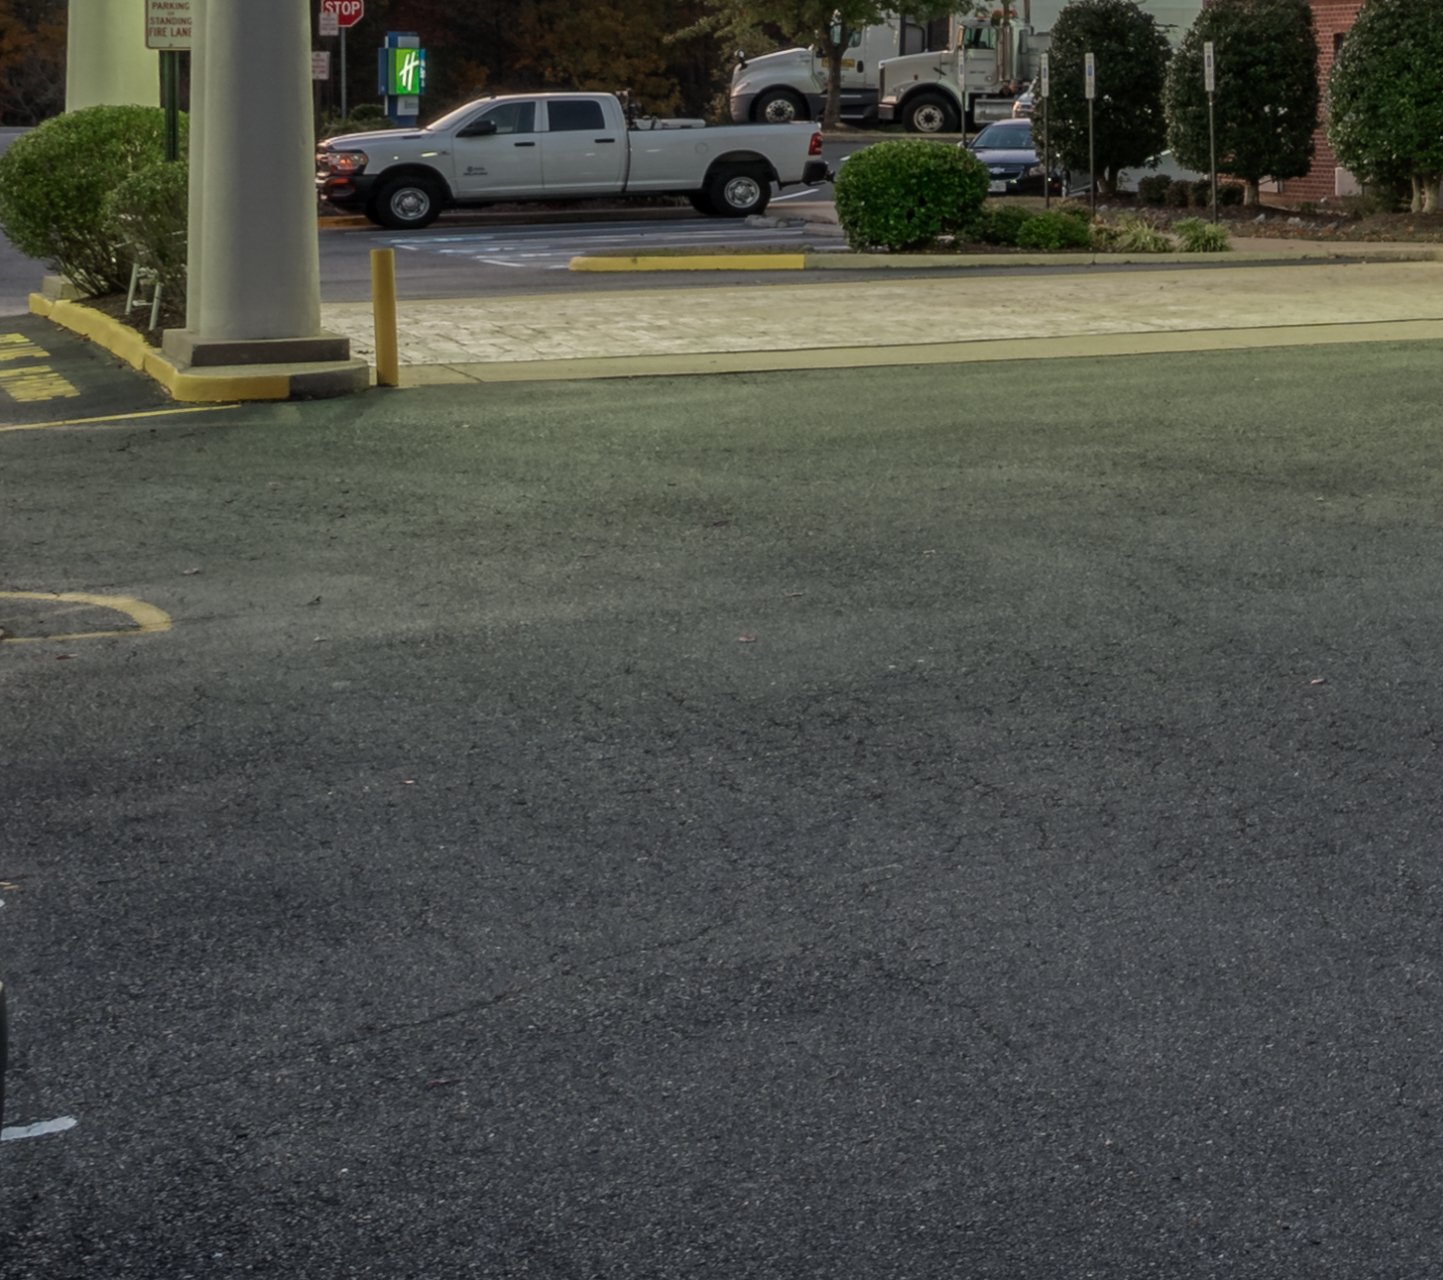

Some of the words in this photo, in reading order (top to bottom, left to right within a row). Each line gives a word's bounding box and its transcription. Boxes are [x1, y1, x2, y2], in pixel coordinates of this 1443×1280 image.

[152, 2, 190, 10] PARKING
[325, 1, 360, 15] STOP
[148, 27, 167, 37] FIRE
